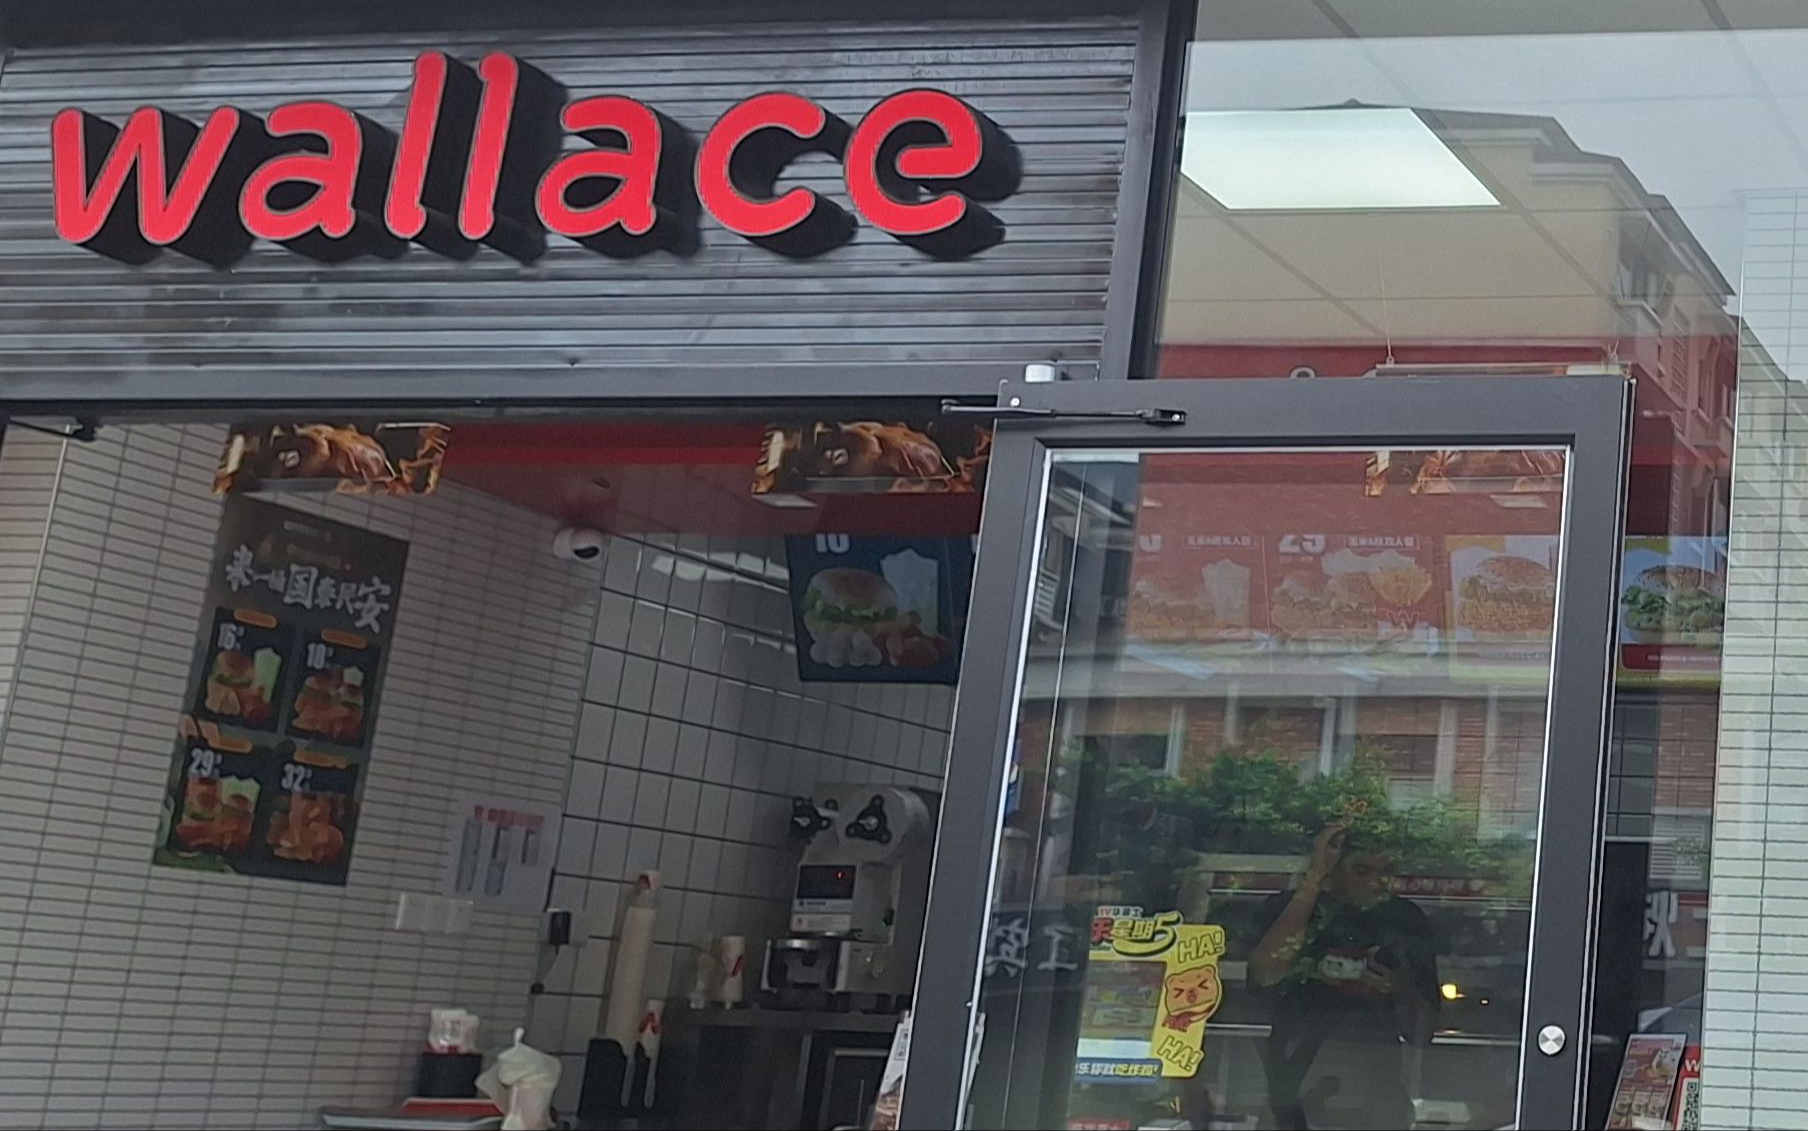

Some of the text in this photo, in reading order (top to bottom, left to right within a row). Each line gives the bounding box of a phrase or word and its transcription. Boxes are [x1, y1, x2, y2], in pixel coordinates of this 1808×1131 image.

[50, 51, 983, 244] wallace
[1178, 929, 1224, 964] HA!
[1156, 1034, 1203, 1073] HA!
